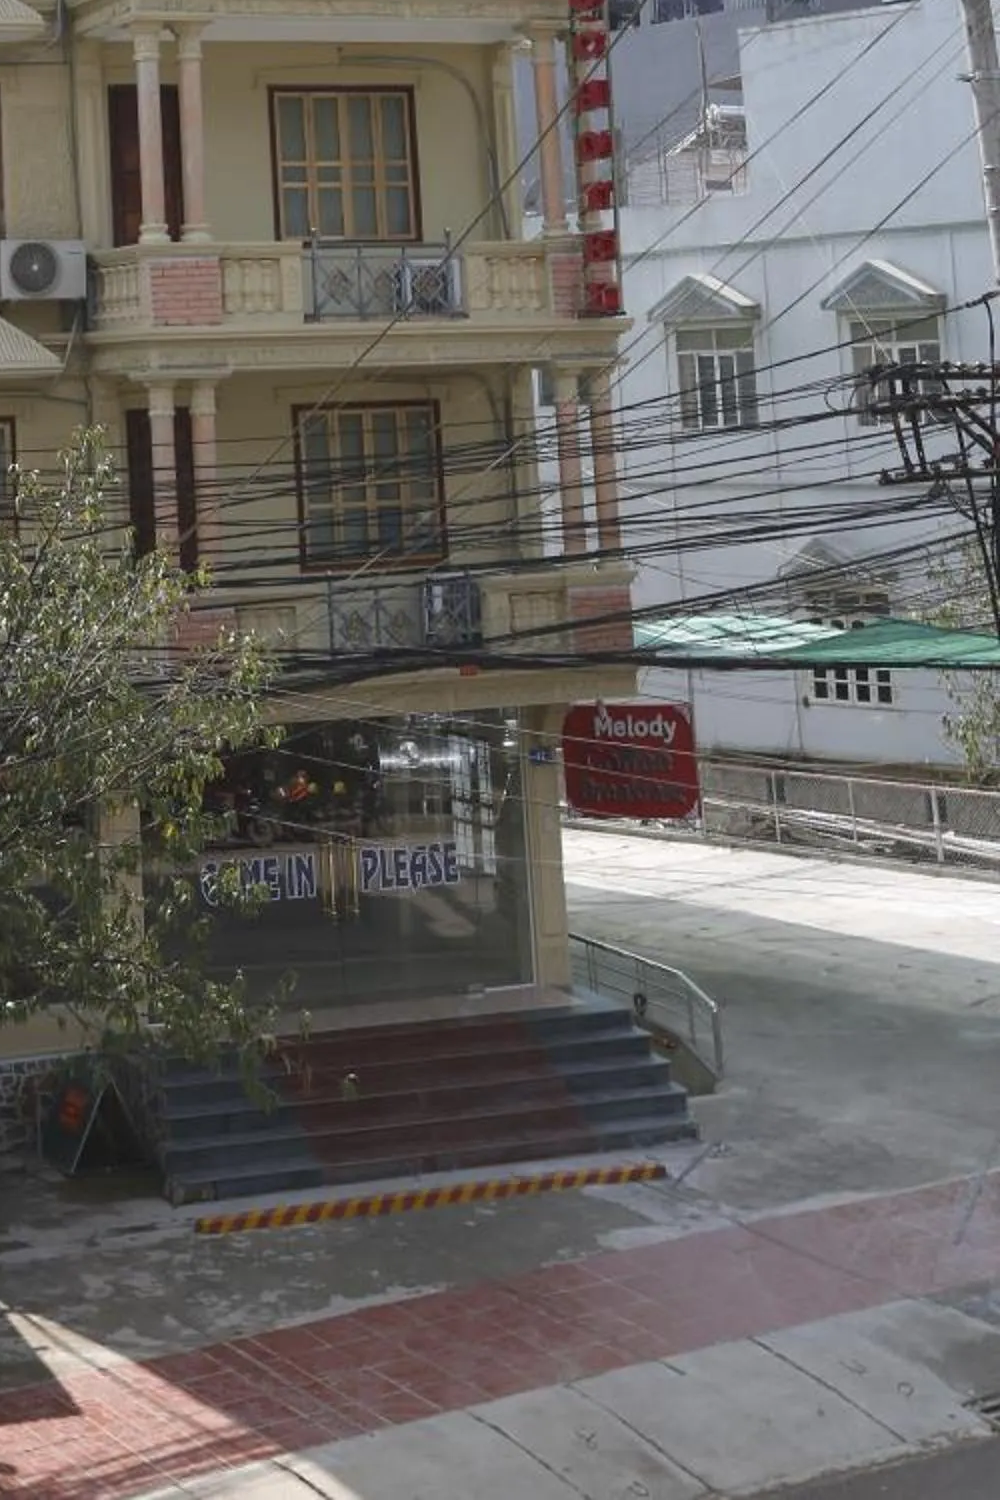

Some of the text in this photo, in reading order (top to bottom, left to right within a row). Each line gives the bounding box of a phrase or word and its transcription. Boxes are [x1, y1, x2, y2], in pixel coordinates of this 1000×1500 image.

[593, 713, 677, 743] Melody
[200, 842, 462, 907] CME IN PLEASE
